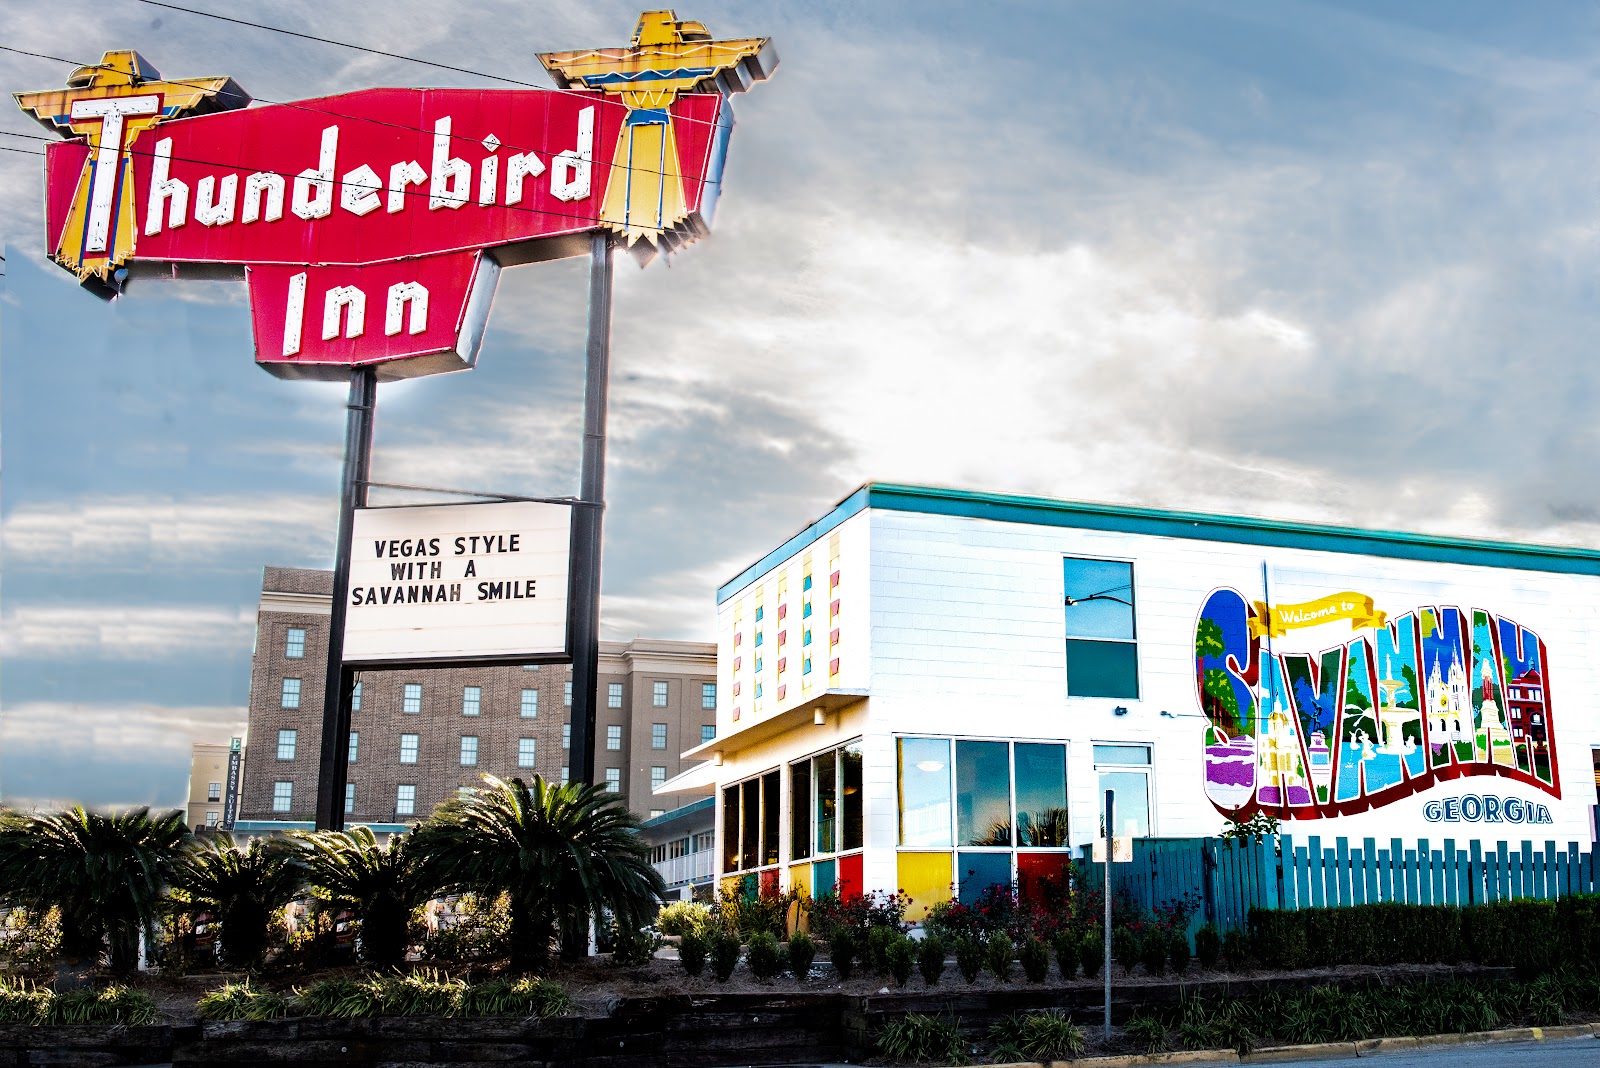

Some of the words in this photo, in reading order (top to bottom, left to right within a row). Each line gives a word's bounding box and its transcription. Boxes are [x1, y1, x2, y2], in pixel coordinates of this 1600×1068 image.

[70, 96, 595, 253] Thunderbird
[282, 271, 429, 357] Inn
[374, 538, 440, 558] VEGAS
[454, 534, 520, 555] STYLE
[391, 561, 442, 580] WITH
[464, 560, 477, 577] A
[352, 583, 461, 605] SAVANNAH
[477, 580, 536, 600] SMILE
[1279, 605, 1337, 623] Welcome
[1341, 600, 1355, 611] to
[1193, 586, 1562, 822] SAVANNAH
[230, 755, 238, 790] EMBASSY
[227, 794, 235, 825] SUITES
[1423, 795, 1553, 824] GEORGIA
